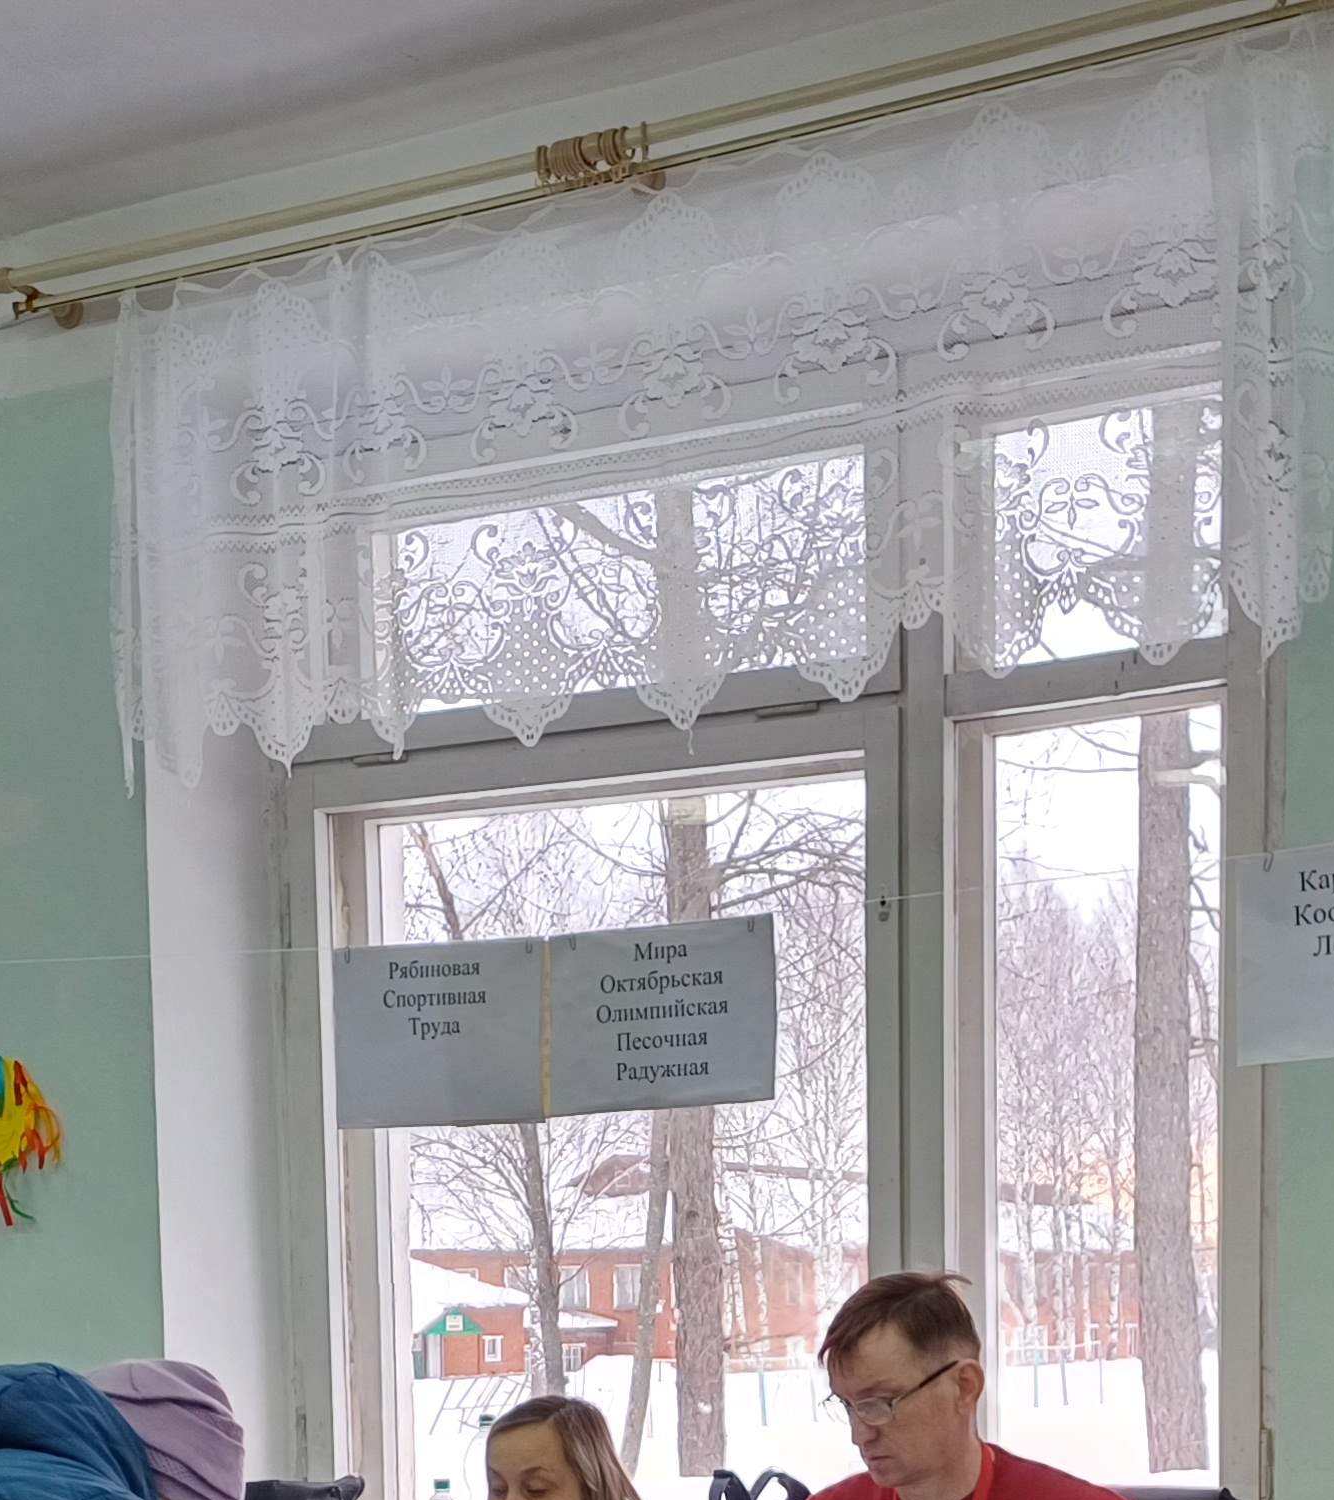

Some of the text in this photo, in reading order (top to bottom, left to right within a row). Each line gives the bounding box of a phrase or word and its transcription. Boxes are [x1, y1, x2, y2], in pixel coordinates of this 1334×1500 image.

[633, 941, 688, 965] Мира
[388, 959, 481, 980] Рябиновая
[599, 969, 724, 995] Октябрьская
[382, 989, 487, 1013] Спортивная
[596, 998, 729, 1025] Олимпийская
[407, 1016, 461, 1041] Труда
[616, 1031, 708, 1052] Песочная
[615, 1061, 710, 1085] Радужная
